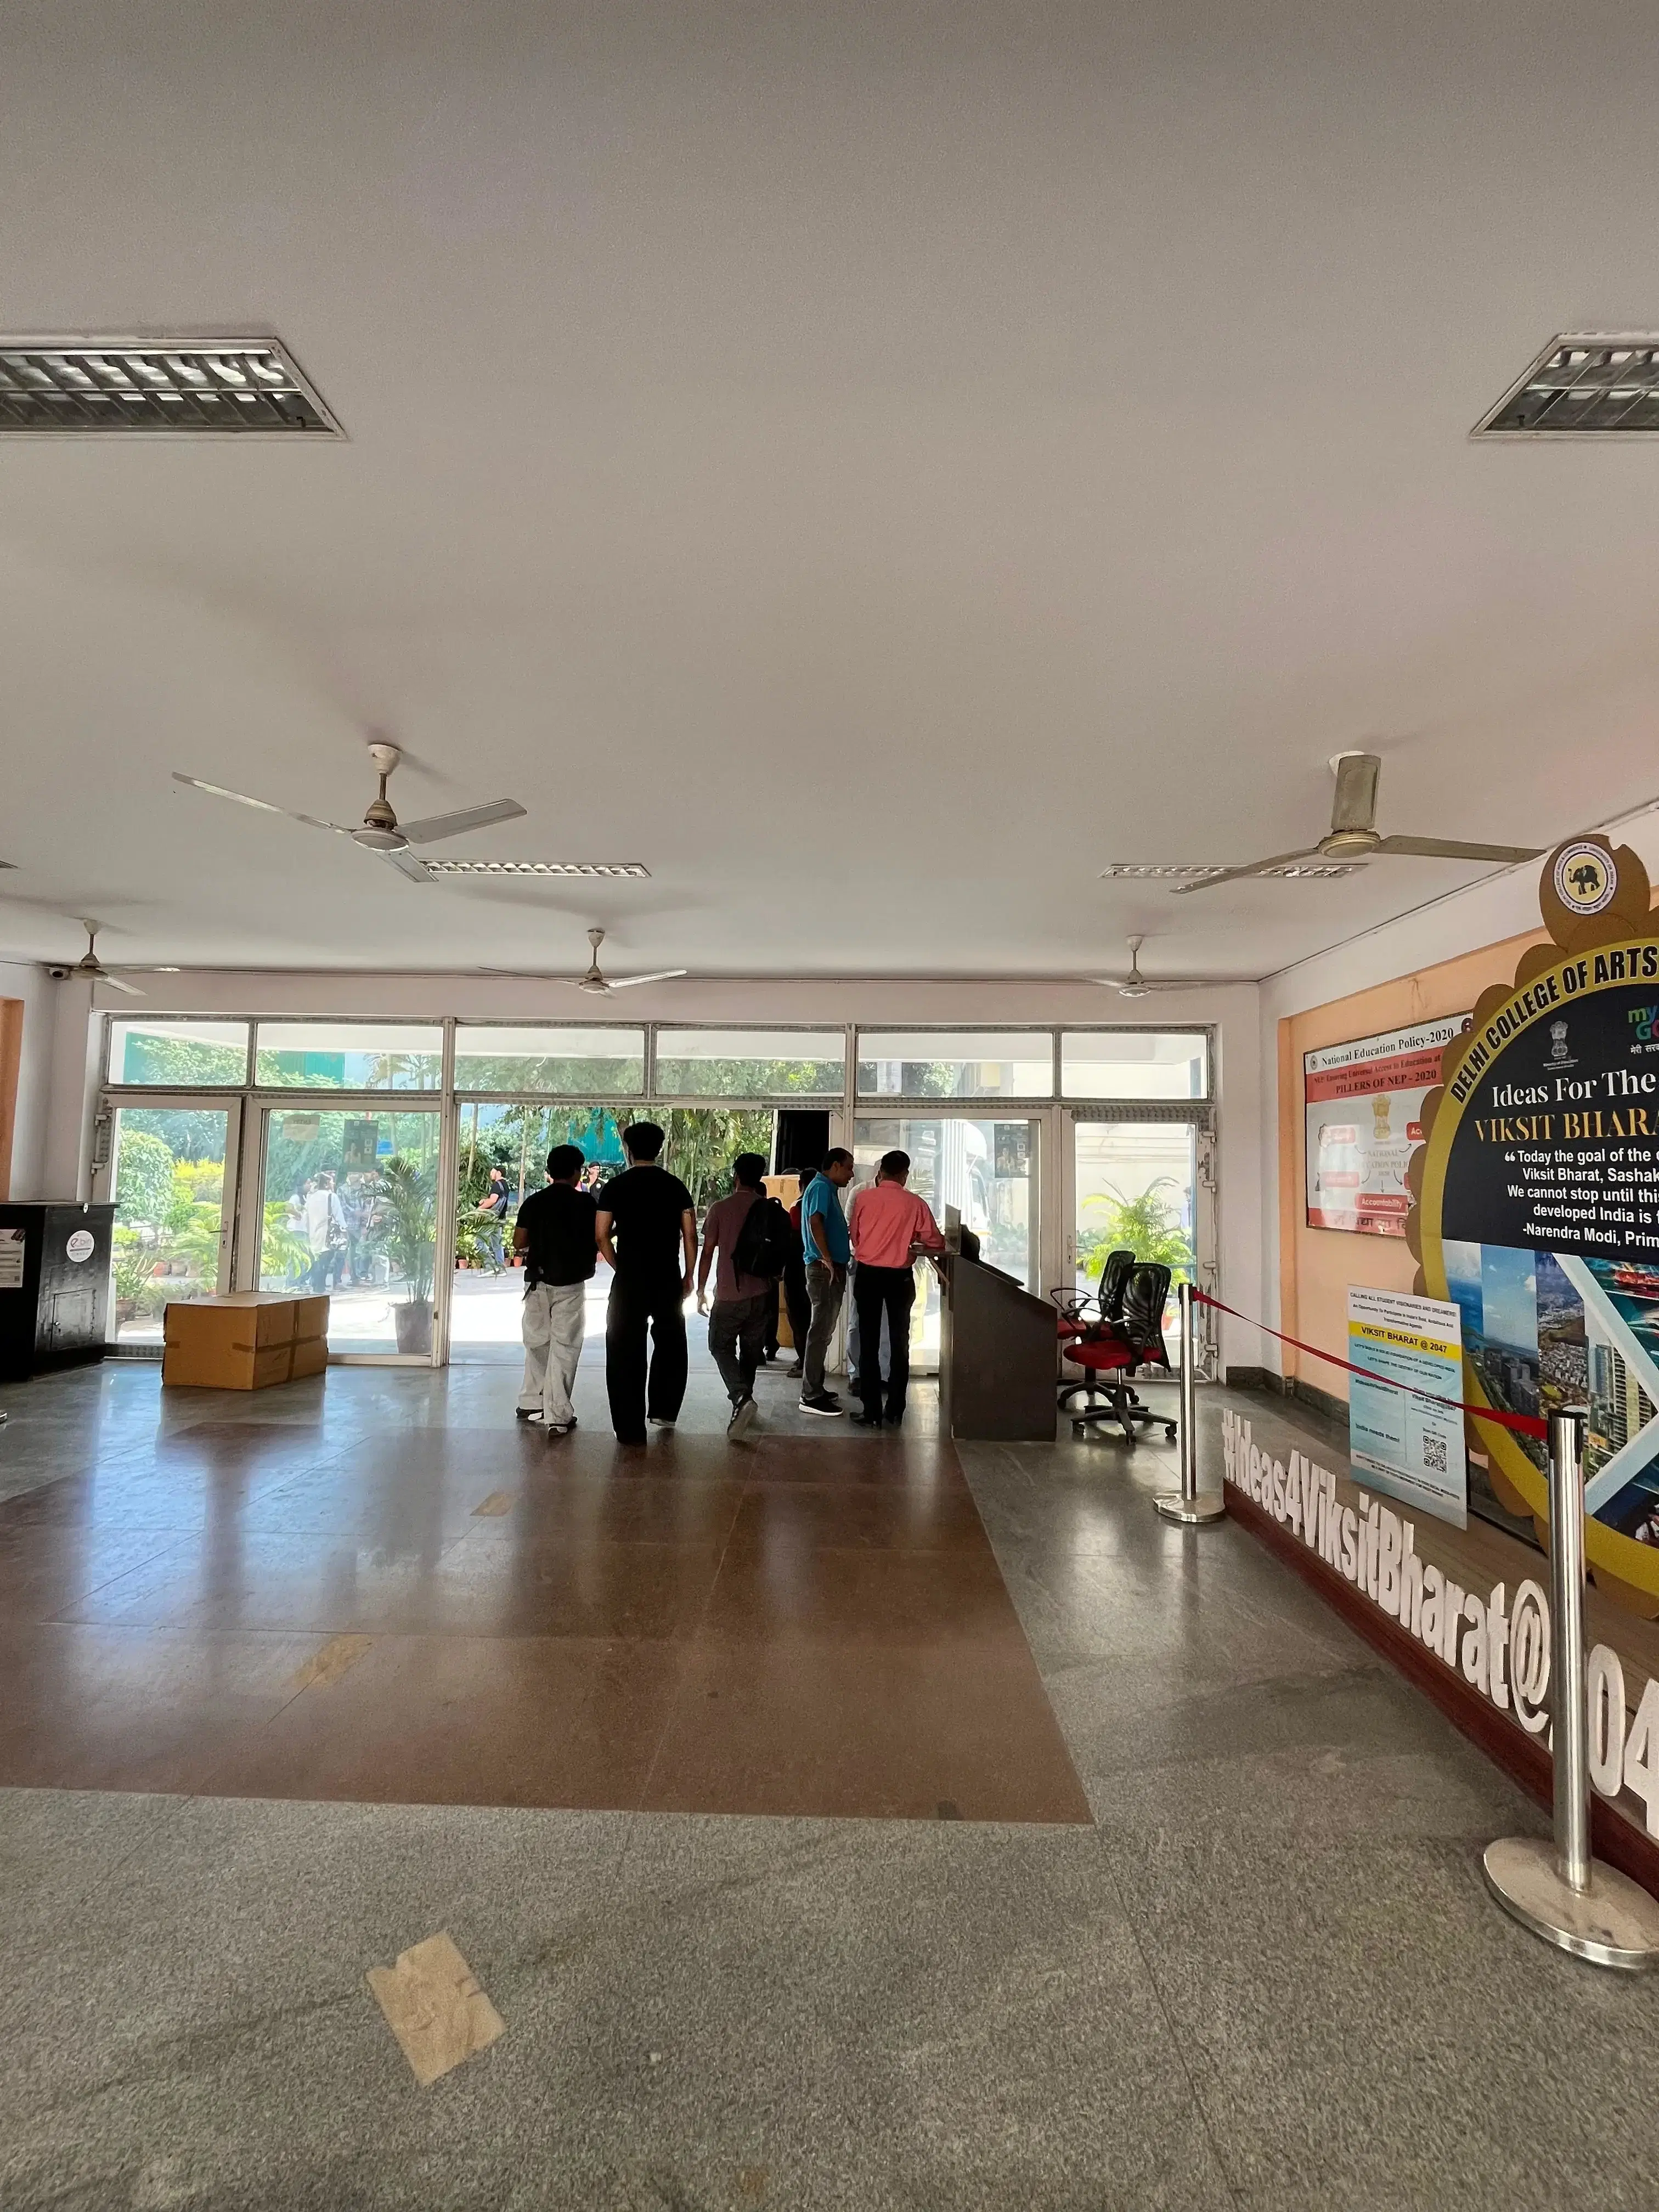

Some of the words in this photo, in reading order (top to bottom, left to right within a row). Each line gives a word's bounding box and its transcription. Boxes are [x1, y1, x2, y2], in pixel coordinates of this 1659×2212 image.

[1450, 1041, 1490, 1104] DELHI
[1485, 974, 1561, 1051] COLLEGE
[1562, 960, 1589, 995] OF
[1593, 945, 1658, 985] ARTS
[1322, 1051, 1352, 1066] National
[1354, 1042, 1396, 1059] Education
[1398, 1027, 1454, 1049] Policy-2020
[1630, 1044, 1642, 1054] मेरी
[1401, 1056, 1432, 1069] Education
[1434, 1053, 1441, 1062] at
[1336, 1079, 1371, 1094] PILLERS
[1373, 1077, 1384, 1088] OF
[1387, 1075, 1407, 1085] NEP
[1415, 1069, 1437, 1081] 2020
[1492, 1084, 1548, 1108] Ideas
[1555, 1077, 1598, 1102] For
[1601, 1069, 1657, 1097] The
[1474, 1114, 1556, 1142] VIKSIT
[1554, 1150, 1573, 1162] the
[1577, 1148, 1605, 1165] goal
[1610, 1148, 1624, 1161] of
[1627, 1148, 1651, 1162] the
[1522, 1167, 1555, 1181] Viksit
[1558, 1167, 1604, 1183] Bharat,
[1361, 1198, 1402, 1209] Accountability
[1507, 1184, 1524, 1197] We
[1527, 1187, 1567, 1199] cannot
[1570, 1187, 1599, 1203] stop
[1602, 1188, 1634, 1202] until
[1638, 1189, 1659, 1203] thi
[1533, 1204, 1596, 1222] developed
[1600, 1207, 1634, 1222] India
[1639, 1209, 1652, 1224] is
[1522, 1222, 1581, 1240] -Narendra
[1584, 1227, 1621, 1246] Modi,
[1361, 1326, 1385, 1338] VIKSIT
[1387, 1332, 1418, 1346] BHARAT
[1420, 1340, 1428, 1350] @
[1430, 1342, 1448, 1353] 2047
